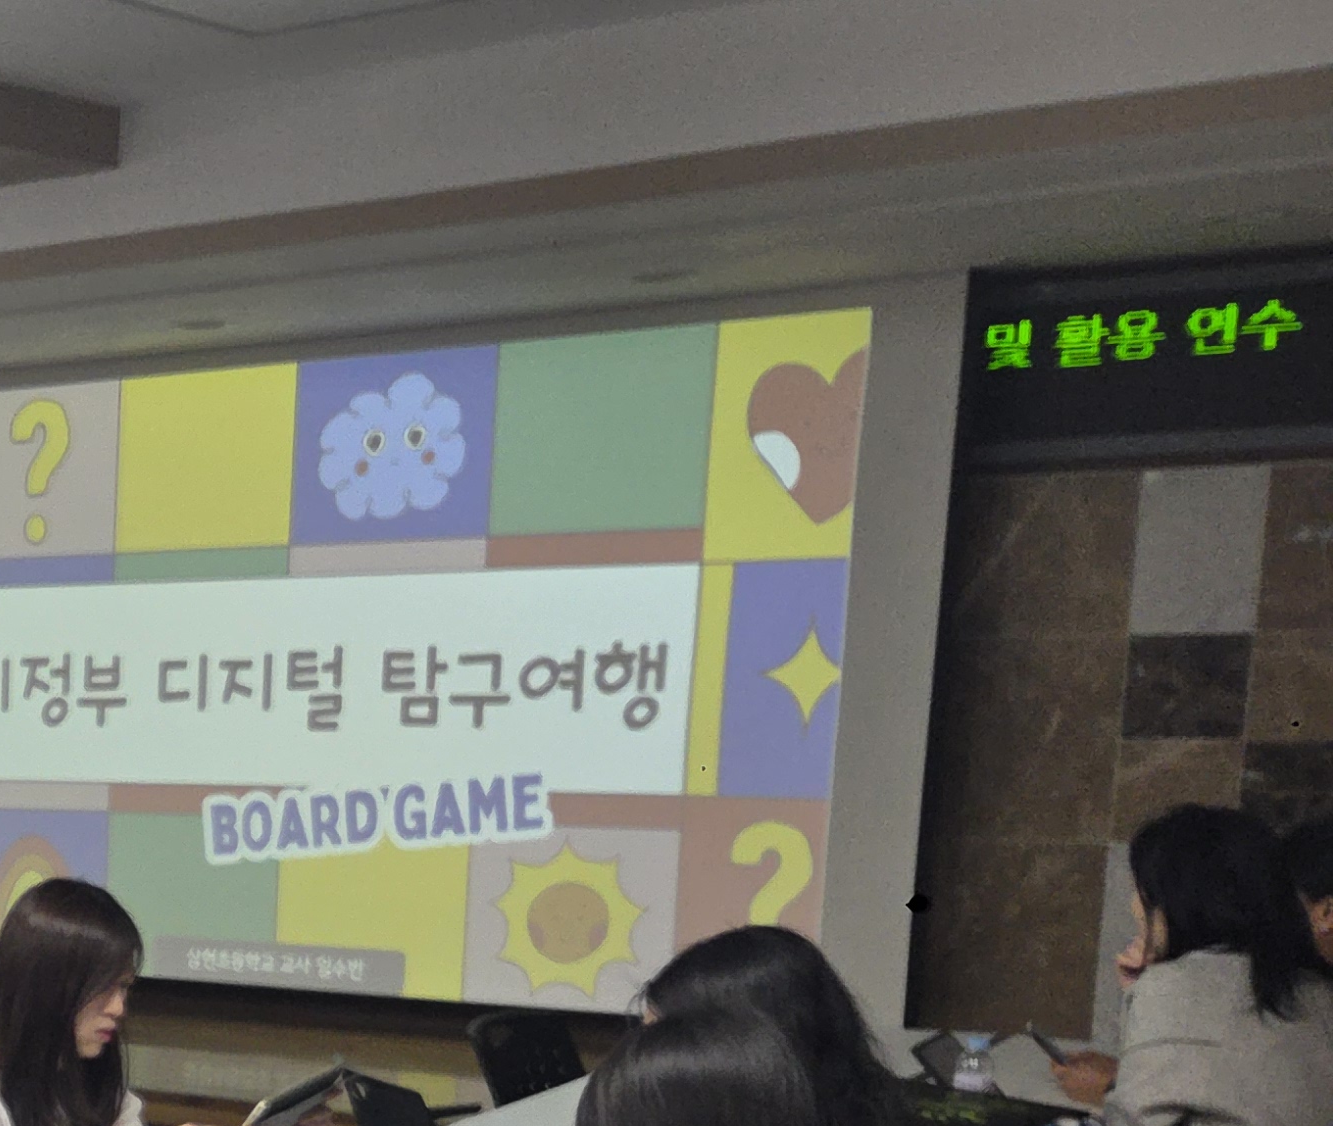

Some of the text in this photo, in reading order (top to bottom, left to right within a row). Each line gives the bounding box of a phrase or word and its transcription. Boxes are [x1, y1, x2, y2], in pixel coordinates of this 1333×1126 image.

[985, 299, 1303, 370] 및 활용 연수
[158, 645, 344, 731] 디지털
[381, 642, 668, 731] 탐구여행
[210, 773, 544, 855] BOARD GAME
